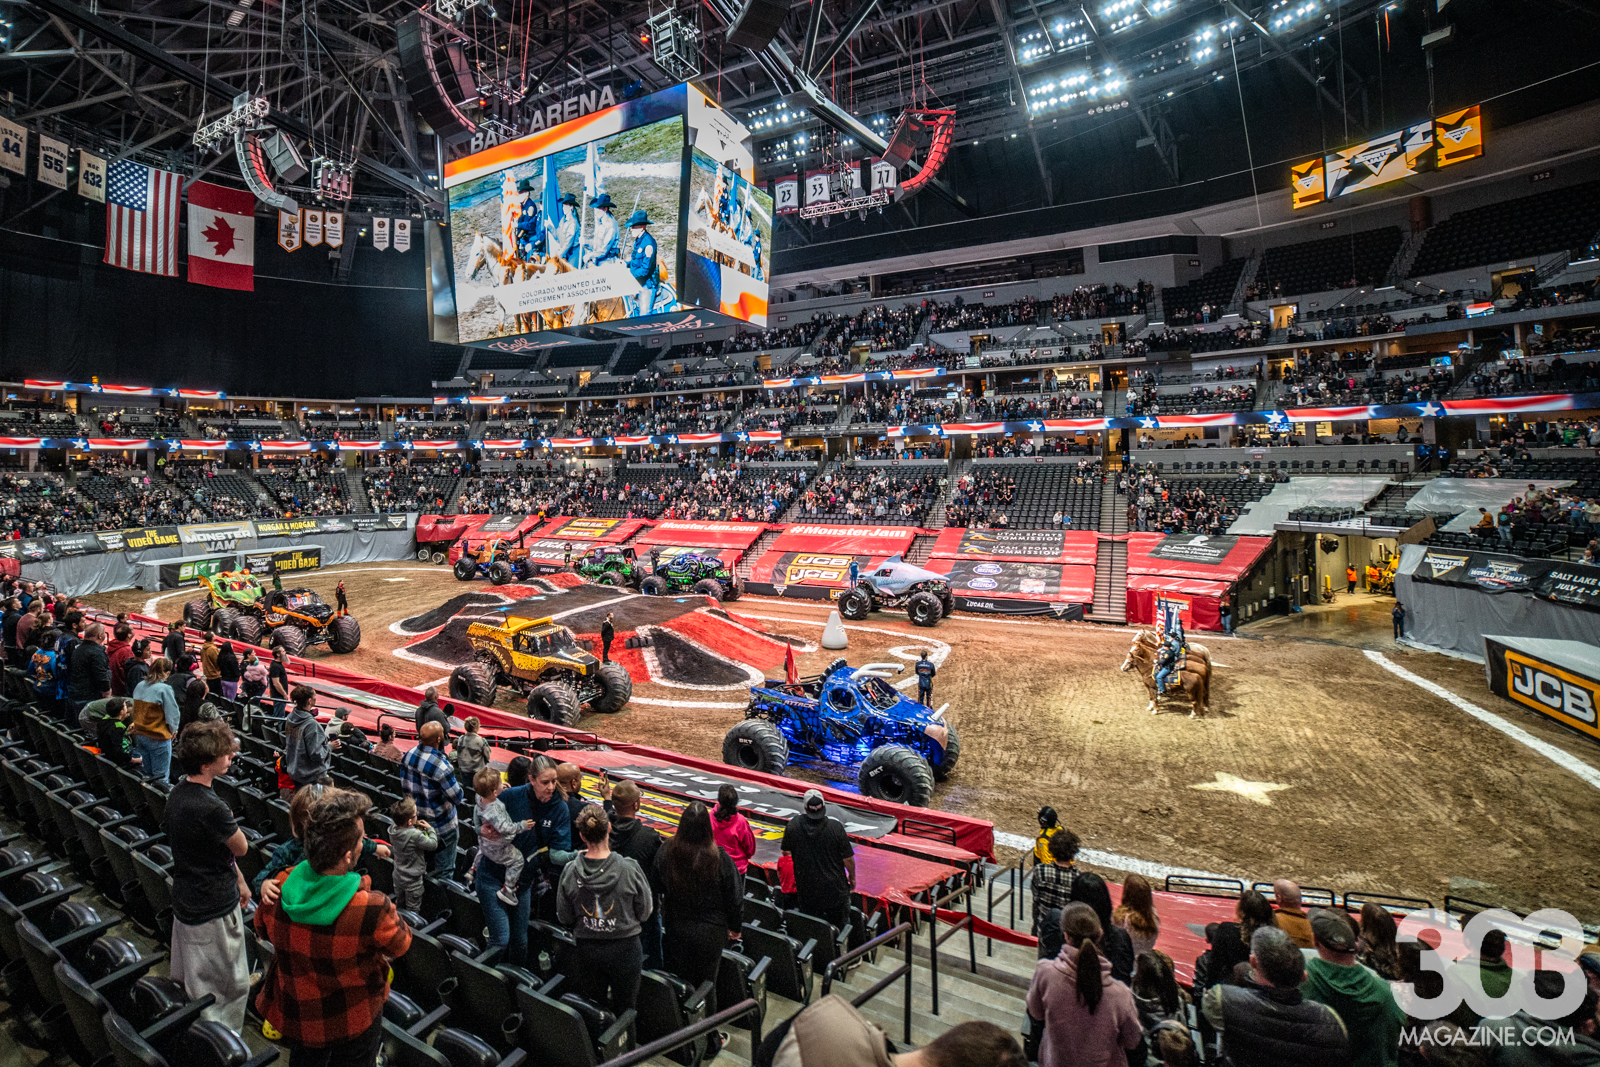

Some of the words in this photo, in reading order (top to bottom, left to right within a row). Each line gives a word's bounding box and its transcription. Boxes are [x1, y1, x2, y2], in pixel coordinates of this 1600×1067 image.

[529, 85, 616, 133] ARENA
[2, 138, 21, 158] 44
[43, 154, 64, 173] 55
[83, 170, 102, 188] 432
[781, 190, 791, 203] 23
[812, 183, 823, 197] 33
[521, 287, 555, 299] COLORADO
[557, 280, 590, 292] MOUNTED
[592, 278, 606, 286] LAW
[518, 293, 565, 306] ENFORCEMENT
[567, 285, 612, 298] ASSOCIATION
[258, 523, 284, 532] MORGAN
[289, 521, 316, 530] MORGAN
[660, 522, 759, 532] MonsterJam.com
[790, 525, 907, 538] #MonsterJam
[144, 530, 157, 538] THE
[184, 530, 251, 544] MONSTER
[127, 537, 153, 548] VIDEO
[155, 534, 179, 545] GAME
[205, 540, 236, 551] JAM
[291, 552, 303, 561] THE
[797, 556, 849, 566] JCB
[1423, 557, 1464, 568] MONSTER
[180, 563, 219, 577] BKT
[275, 559, 297, 570] VIDEO
[298, 557, 319, 569] GAME
[790, 568, 840, 580] JCB
[1470, 570, 1496, 578] WORLD
[1549, 571, 1573, 581] SALT
[1572, 575, 1598, 586] LAKE
[1555, 583, 1578, 591] JULY
[1514, 667, 1596, 723] JCB
[783, 700, 816, 711] ATTACK
[869, 766, 883, 777] BKT
